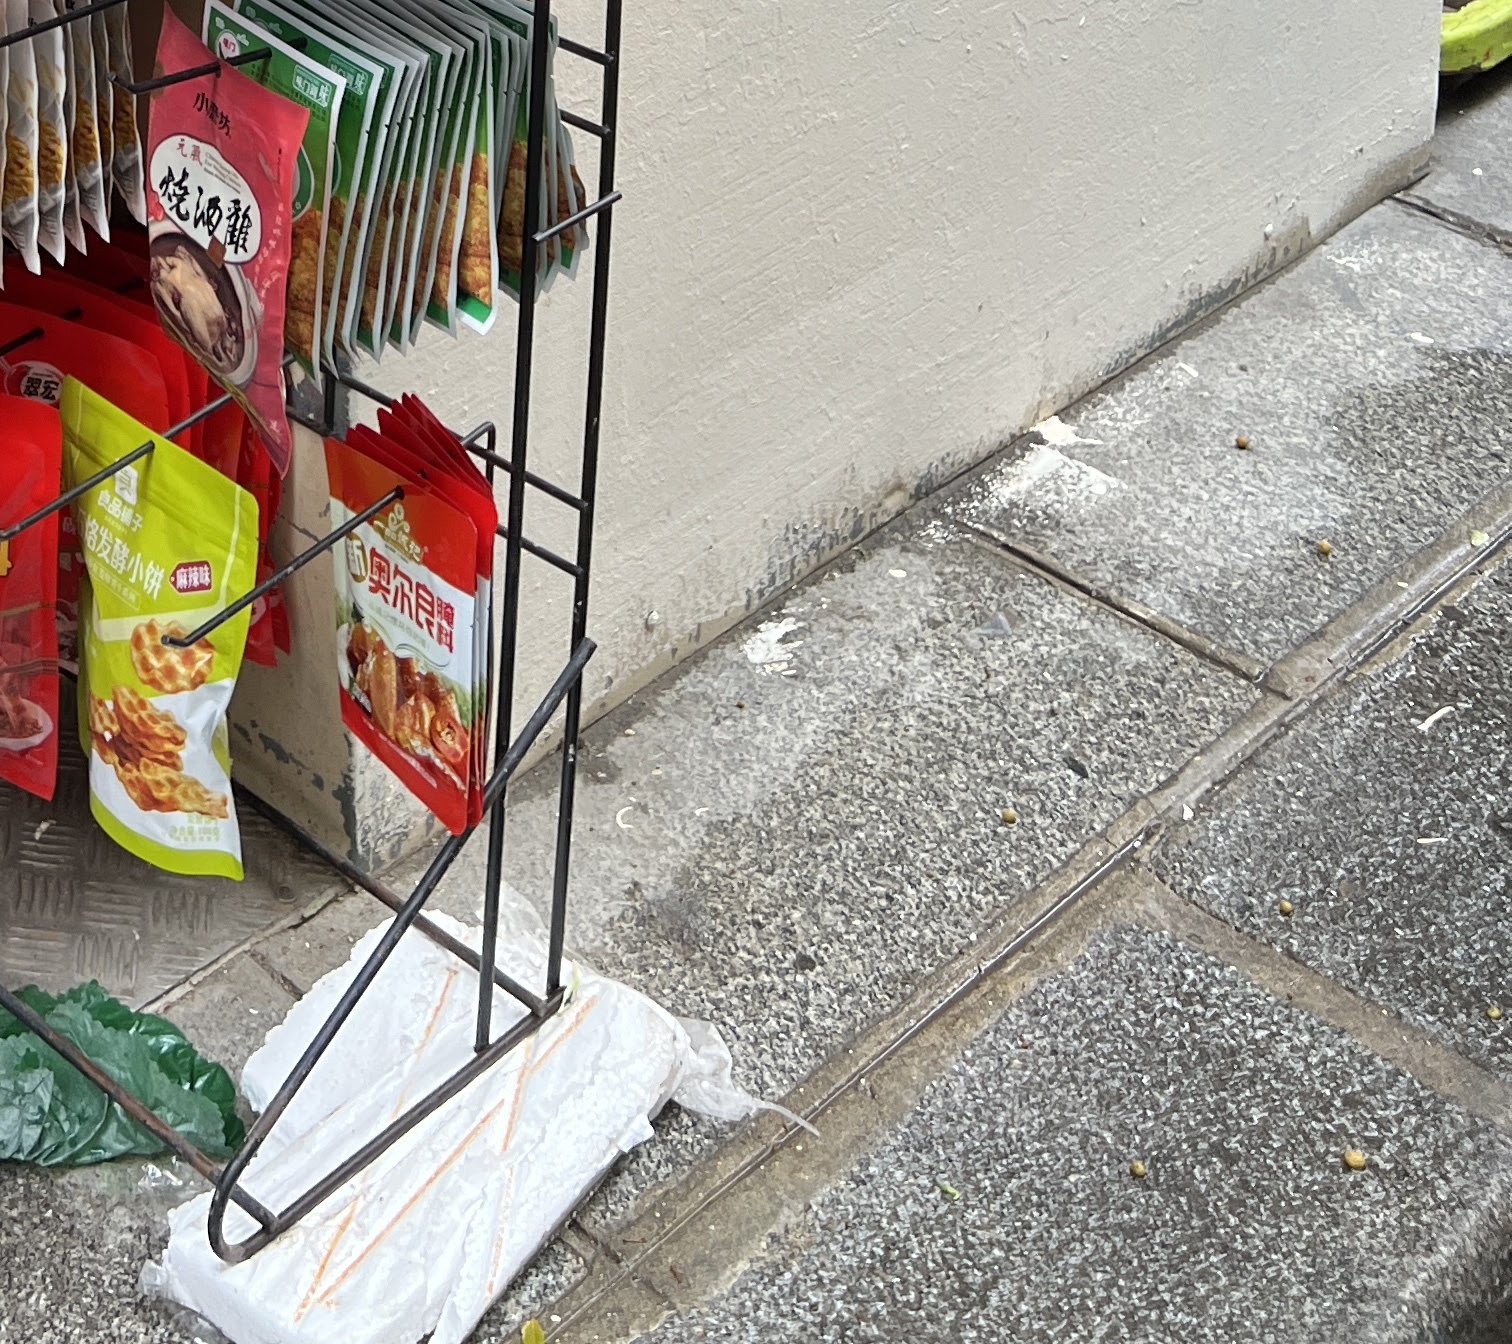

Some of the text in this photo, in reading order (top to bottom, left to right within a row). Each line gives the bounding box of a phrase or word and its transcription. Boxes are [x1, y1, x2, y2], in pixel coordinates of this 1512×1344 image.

[158, 164, 255, 256] 燒酒雞
[174, 564, 212, 592] 麻辣味
